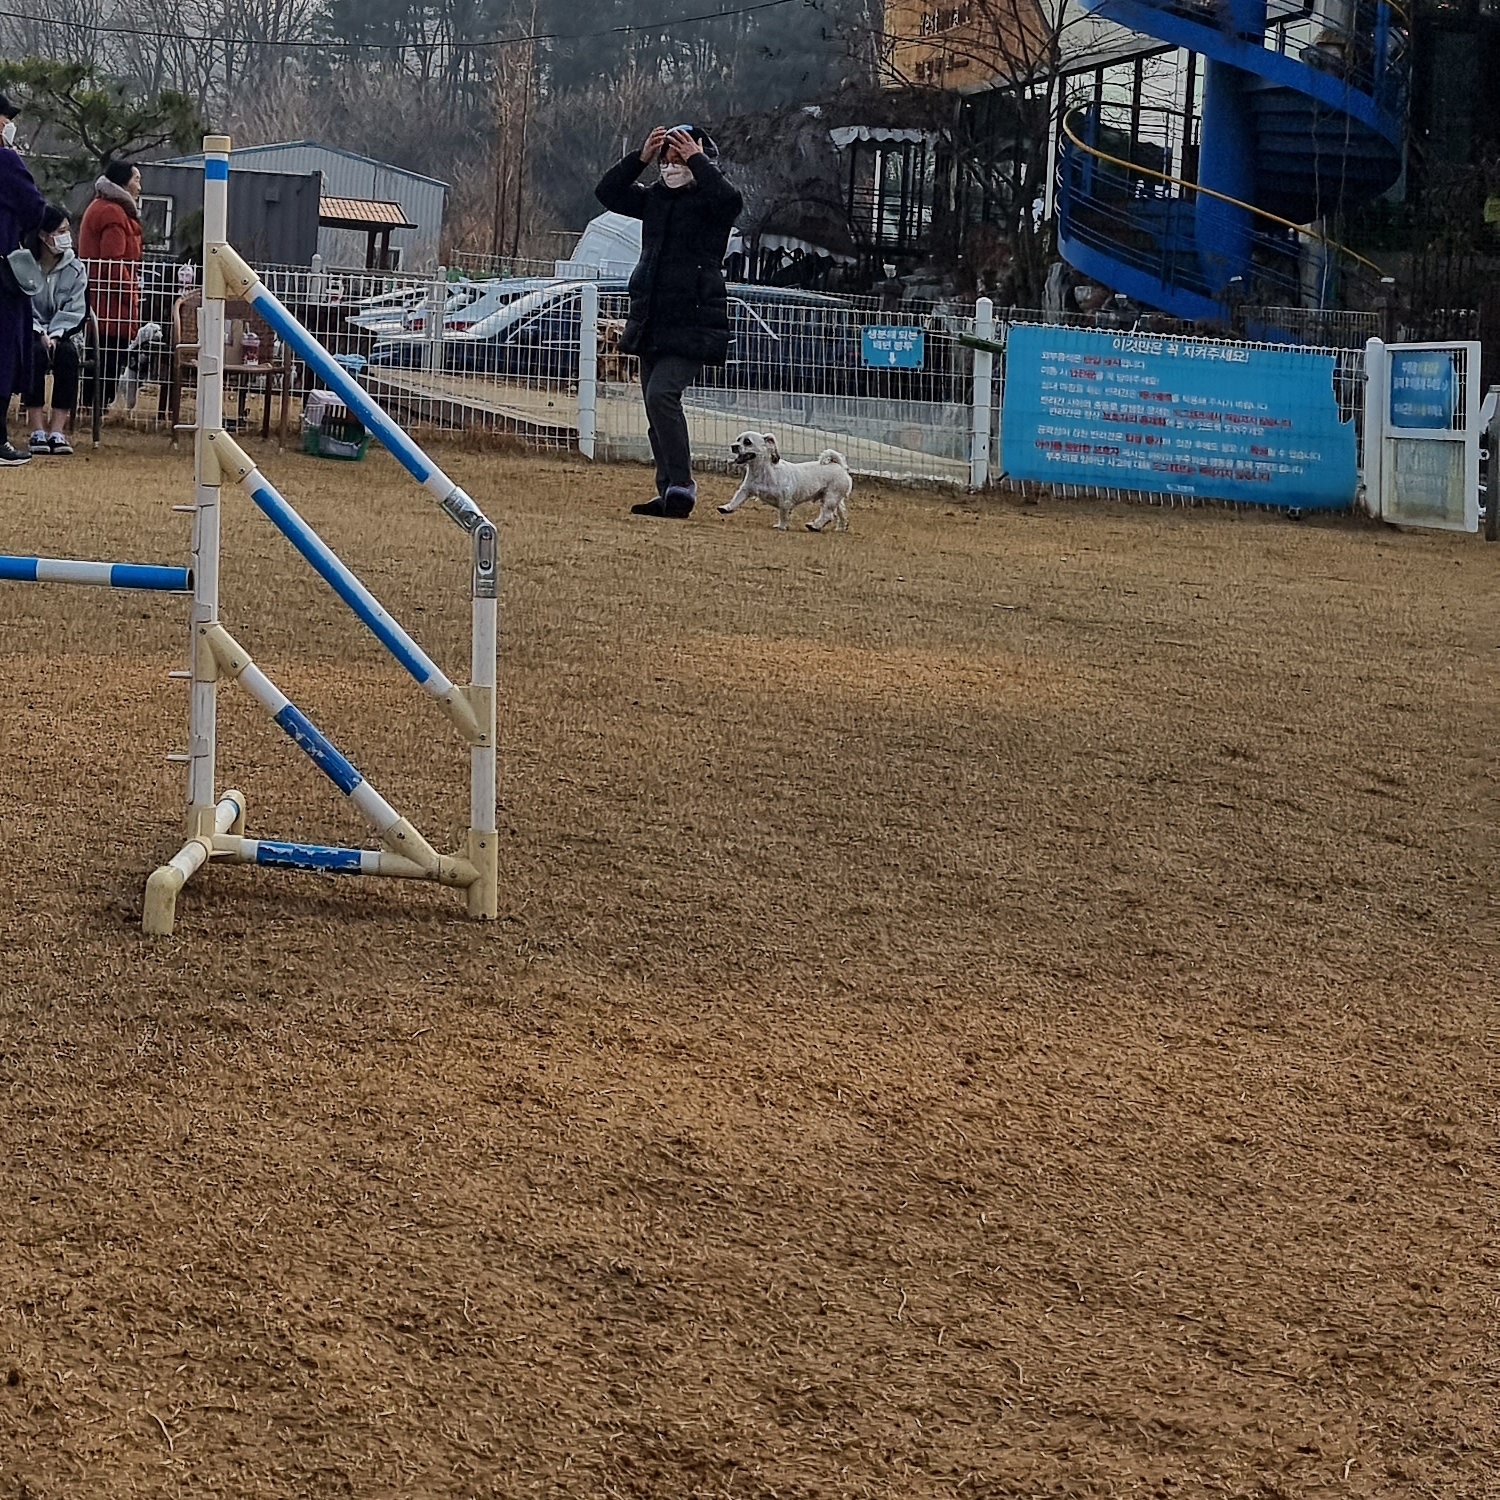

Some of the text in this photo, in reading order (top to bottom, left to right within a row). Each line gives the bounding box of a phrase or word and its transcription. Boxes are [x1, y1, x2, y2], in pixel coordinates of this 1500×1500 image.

[1113, 338, 1249, 362] 이것만은 꼭 지켜주세요!
[1041, 352, 1081, 363] 외부음식은
[1060, 368, 1068, 376] 시
[1050, 408, 1081, 419] 반려견은
[1187, 420, 1194, 430] 수
[1197, 422, 1222, 433] 있도록
[1038, 424, 1070, 437] 공격성이
[1090, 430, 1124, 442] 반려견은
[1034, 439, 1062, 452] 아이를
[1080, 455, 1104, 466] 일어난
